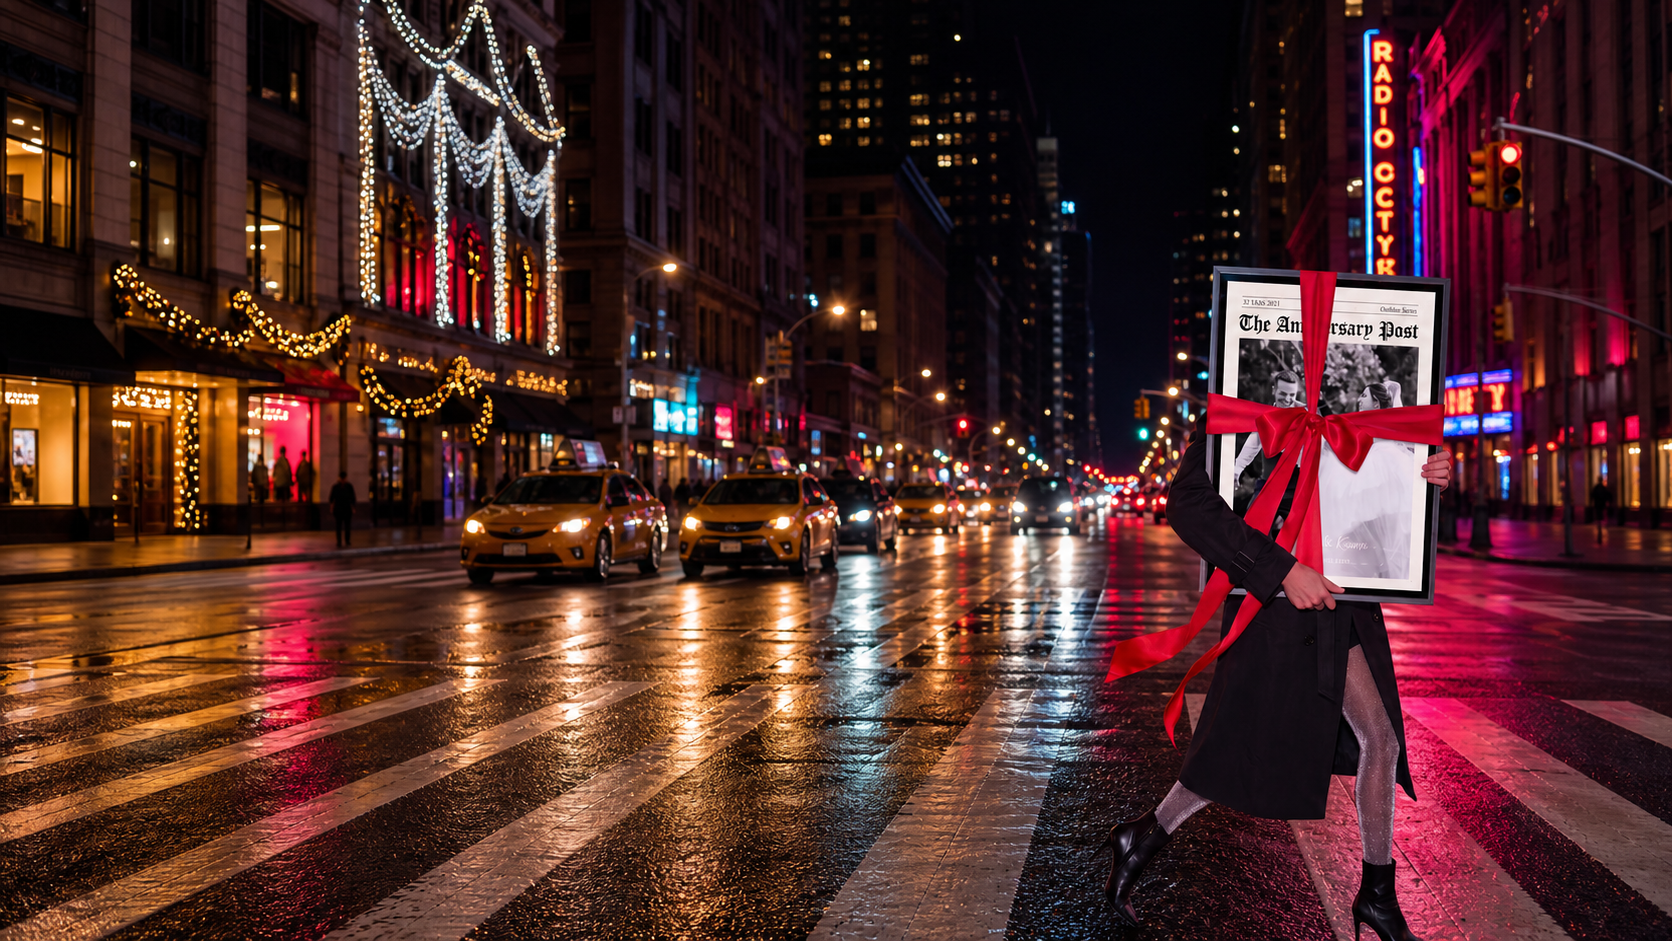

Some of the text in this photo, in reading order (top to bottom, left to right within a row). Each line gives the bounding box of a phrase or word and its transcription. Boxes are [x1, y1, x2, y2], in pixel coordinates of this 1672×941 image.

[1373, 41, 1395, 149] RADIO
[1239, 314, 1419, 341] The Anrsary Post
